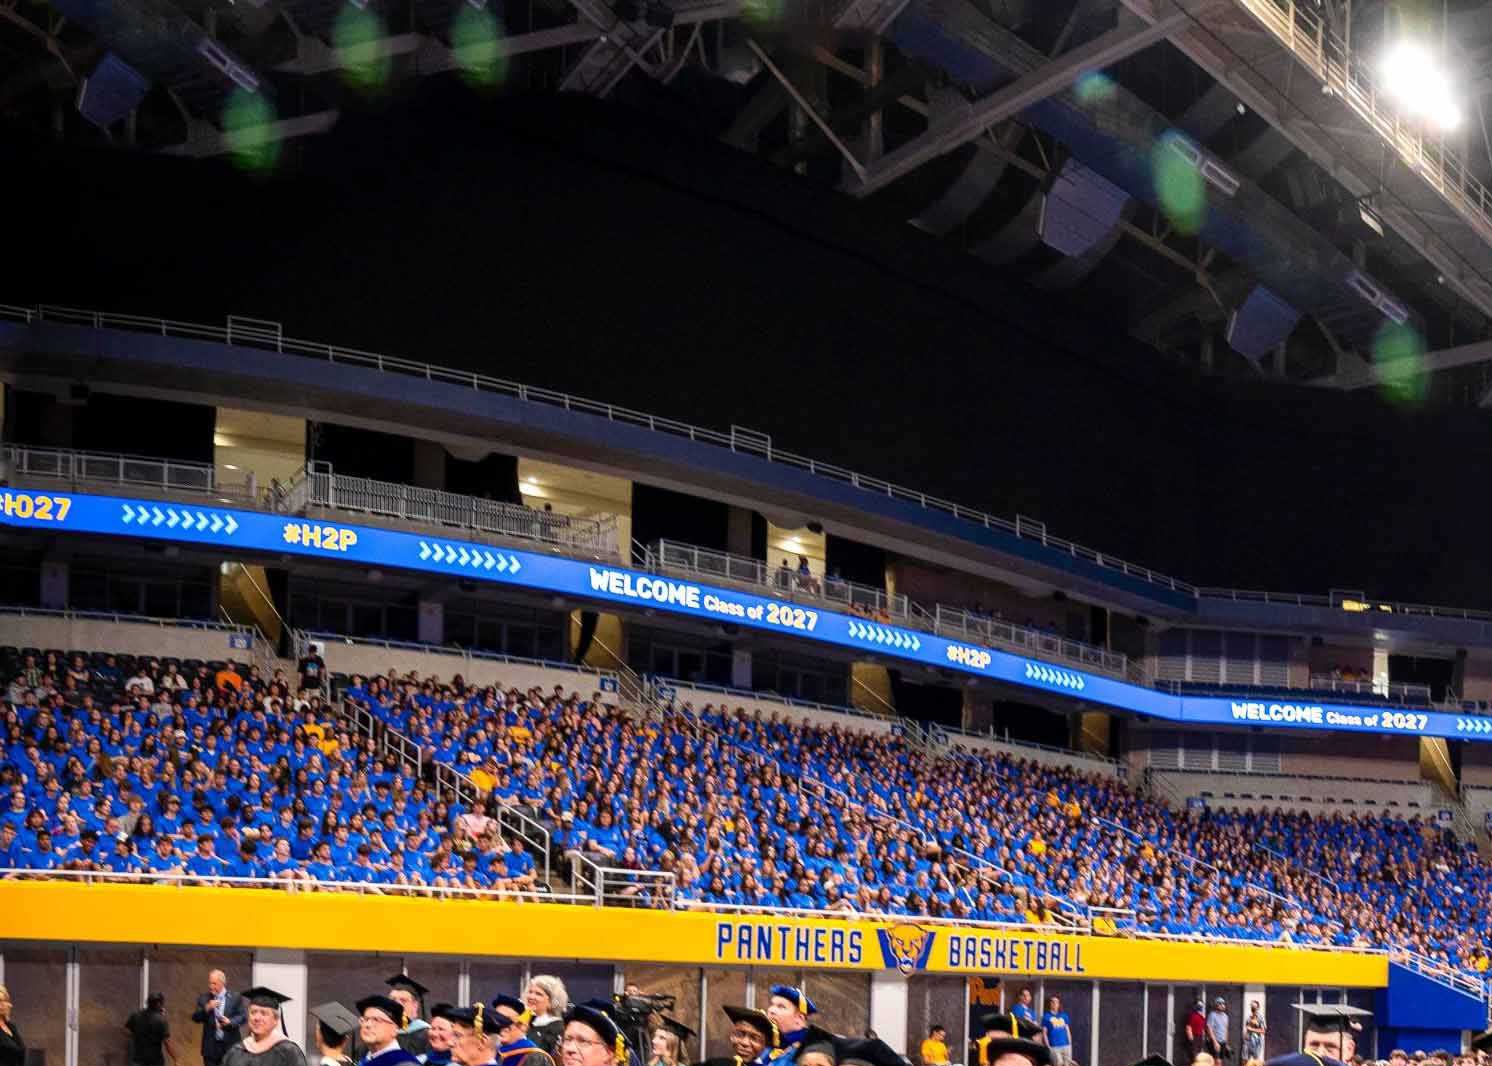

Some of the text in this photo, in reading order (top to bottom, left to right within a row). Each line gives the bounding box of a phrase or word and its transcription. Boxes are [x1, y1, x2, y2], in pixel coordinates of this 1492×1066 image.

[282, 522, 358, 552] #H2P
[589, 567, 819, 633] WELCOME Class of 2027
[946, 644, 992, 670] #H2P
[1231, 702, 1428, 732] WELCOME Class of 2027
[716, 922, 1086, 974] PANTHERS BASKETBALL
